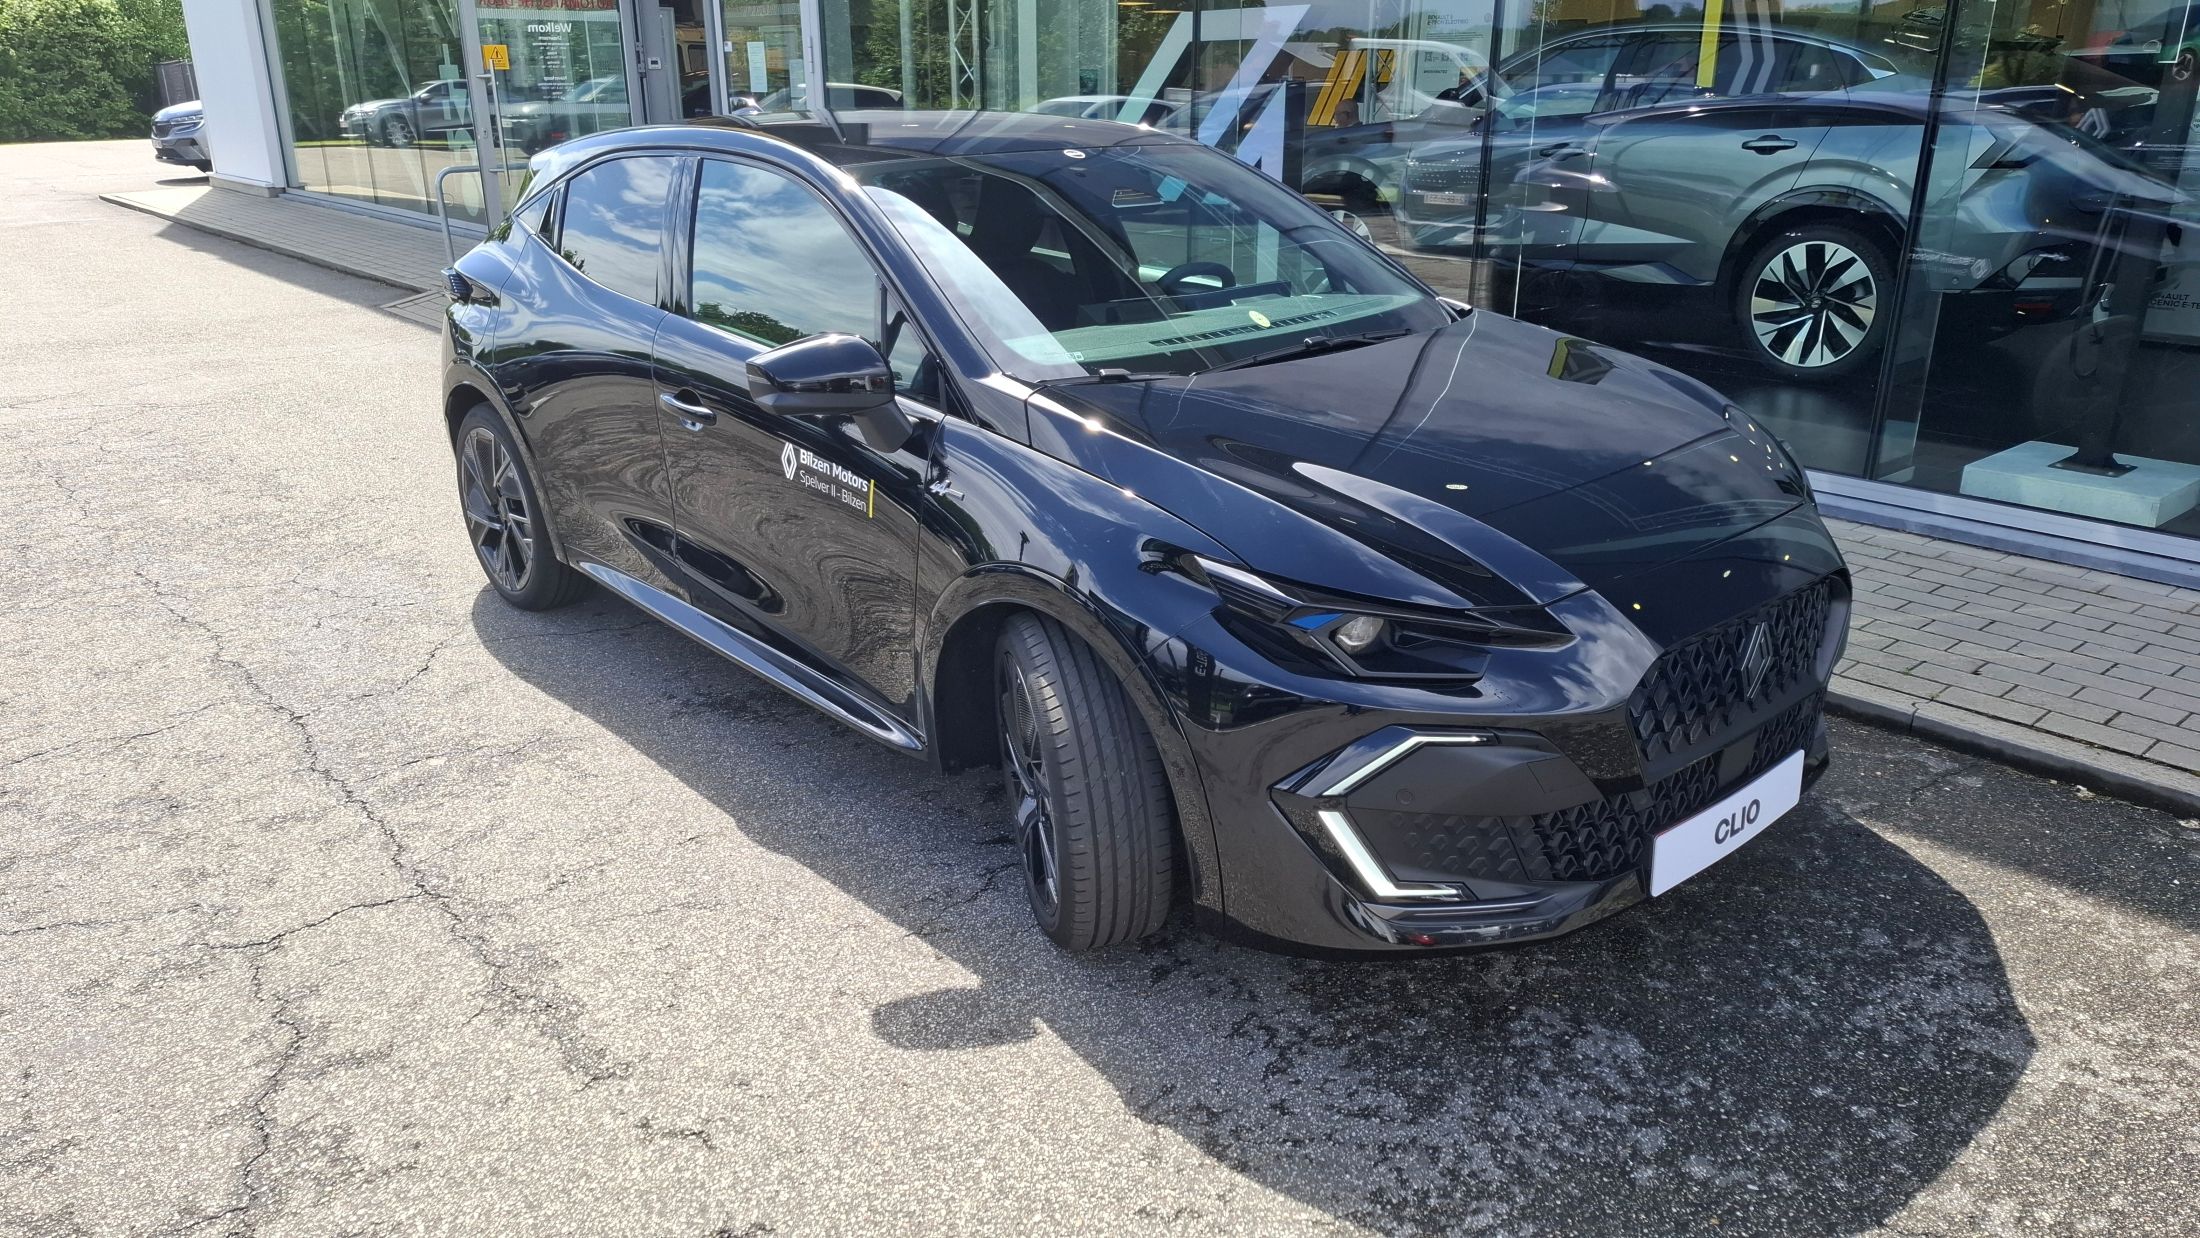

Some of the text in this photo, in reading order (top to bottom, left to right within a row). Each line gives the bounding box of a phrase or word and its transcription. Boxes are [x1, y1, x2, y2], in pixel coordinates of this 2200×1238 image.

[2151, 299, 2180, 307] CENIC
[800, 449, 868, 491] Bilzen Motors
[800, 470, 829, 493] Spelver
[842, 489, 866, 512] Bilzen
[1715, 798, 1761, 845] CLIO
